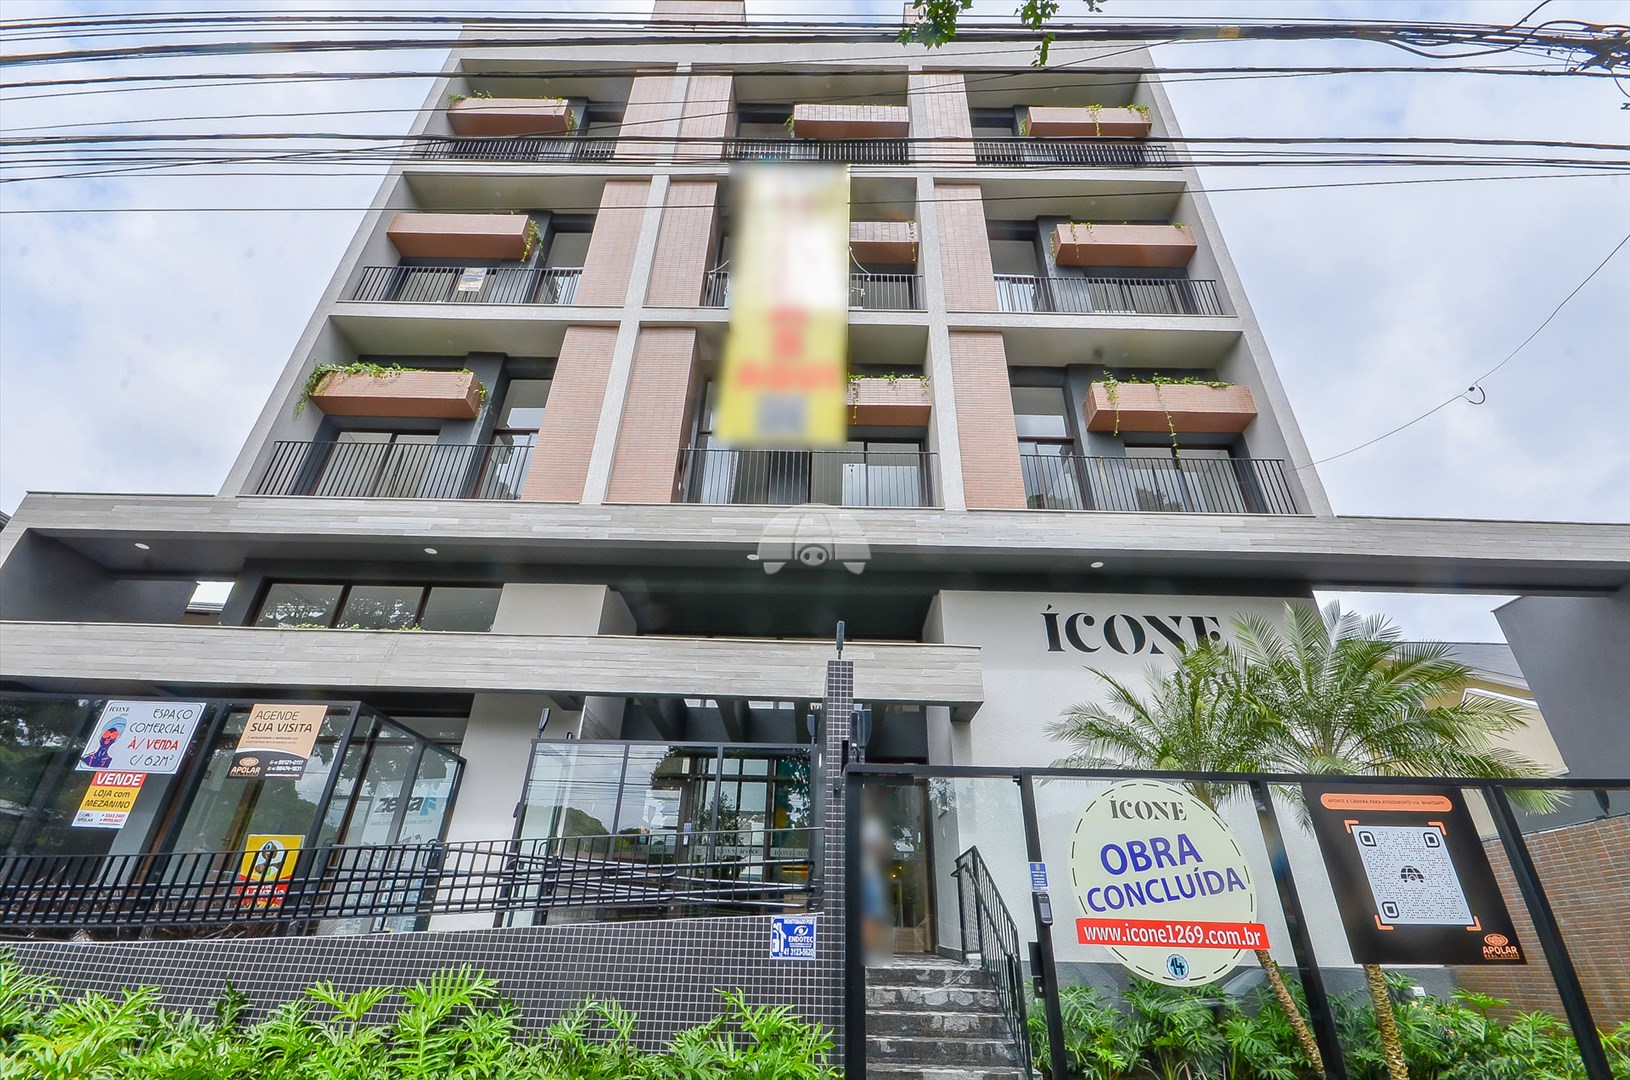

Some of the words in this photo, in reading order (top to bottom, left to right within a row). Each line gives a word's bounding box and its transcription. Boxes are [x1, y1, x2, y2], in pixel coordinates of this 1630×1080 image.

[1040, 603, 1229, 656] ÍCONE
[153, 708, 194, 721] ESPAÇO
[254, 710, 301, 721] AGENDE
[129, 722, 185, 735] COMERCIAL
[249, 722, 273, 732] SUA
[277, 723, 312, 733] VISITA
[147, 739, 179, 751] VENDA
[230, 766, 261, 774] APOLAR
[96, 772, 143, 786] VENDE
[93, 789, 112, 799] LOJA
[113, 790, 131, 798] com
[84, 799, 131, 809] MEZANINO
[1108, 795, 1187, 821] ÍCONE
[1100, 832, 1203, 876] OBRA
[1087, 866, 1247, 912] CONCLUÍDA
[788, 935, 814, 943] ENDOTEC
[1083, 923, 1261, 947] www.icone1269.com.br
[1482, 945, 1519, 955] APOLAR
